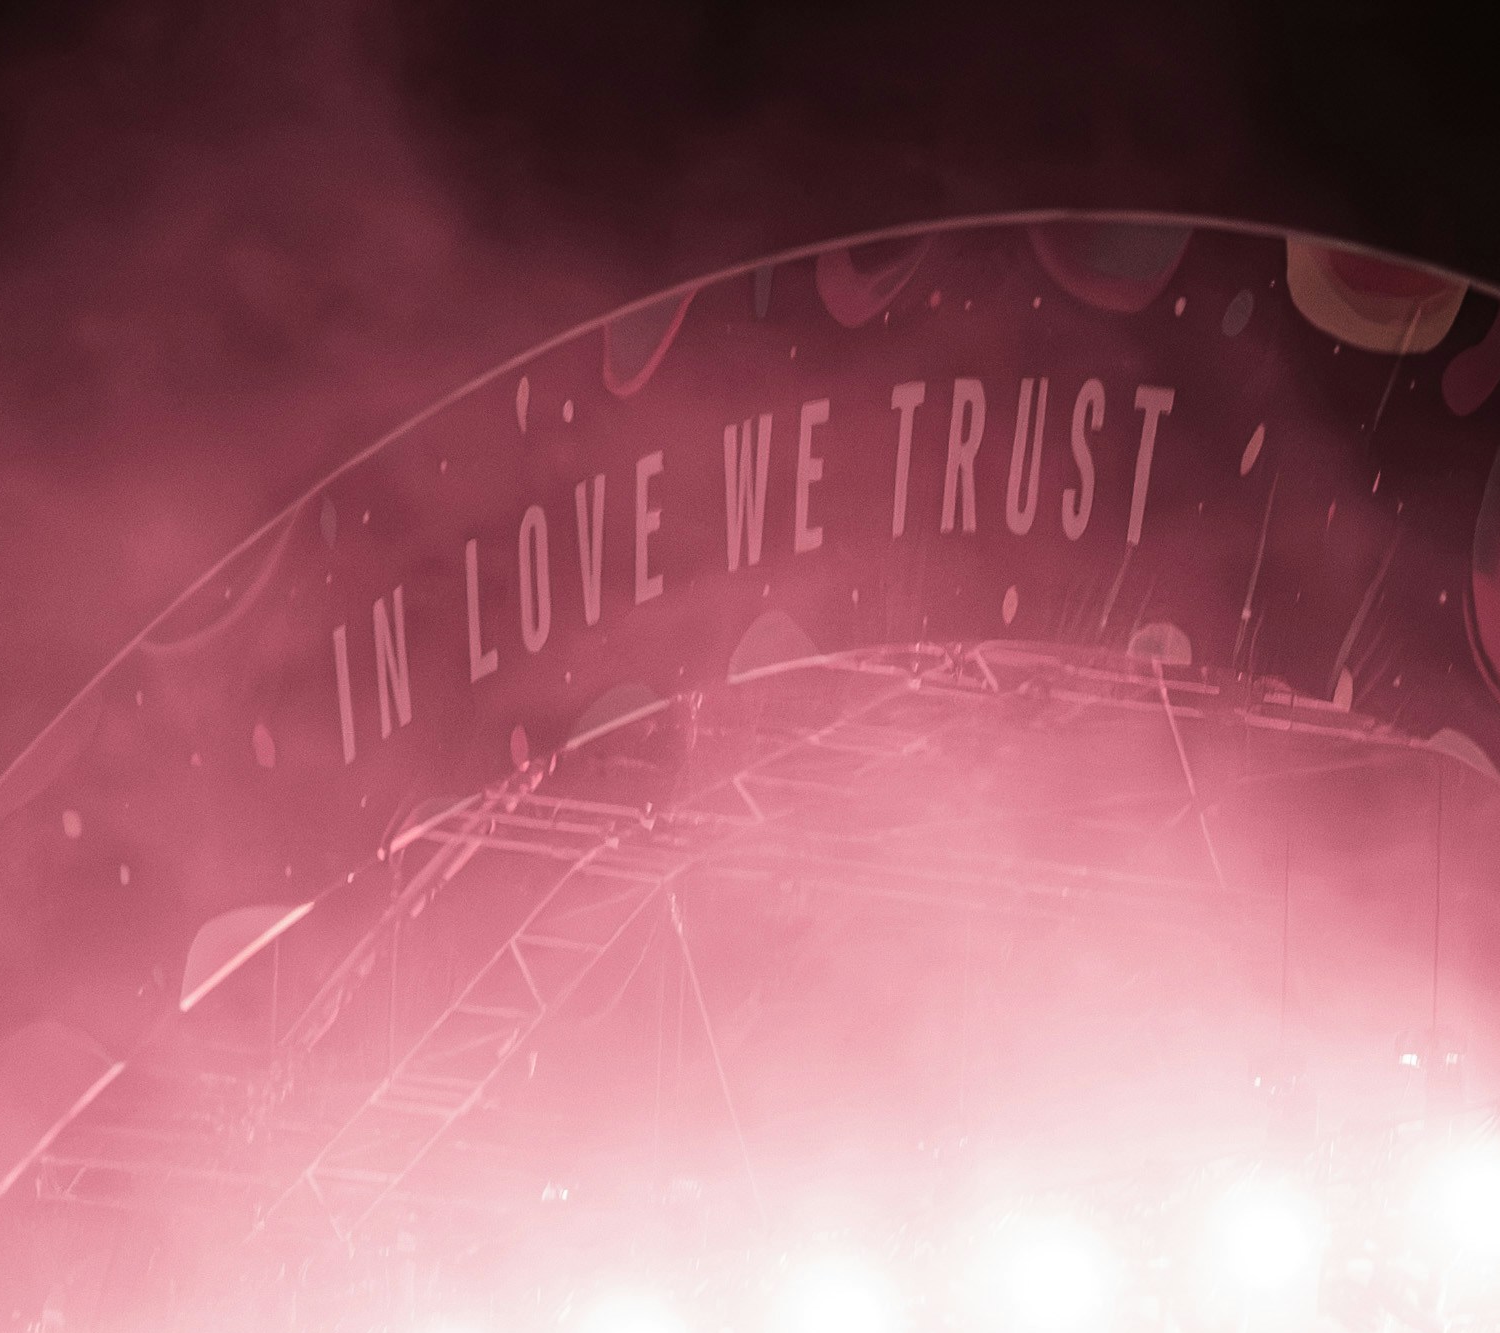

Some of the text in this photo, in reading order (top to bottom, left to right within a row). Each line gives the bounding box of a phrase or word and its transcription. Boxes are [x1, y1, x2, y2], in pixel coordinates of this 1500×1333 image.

[333, 376, 1176, 764] IN LOVE WE TRUST
